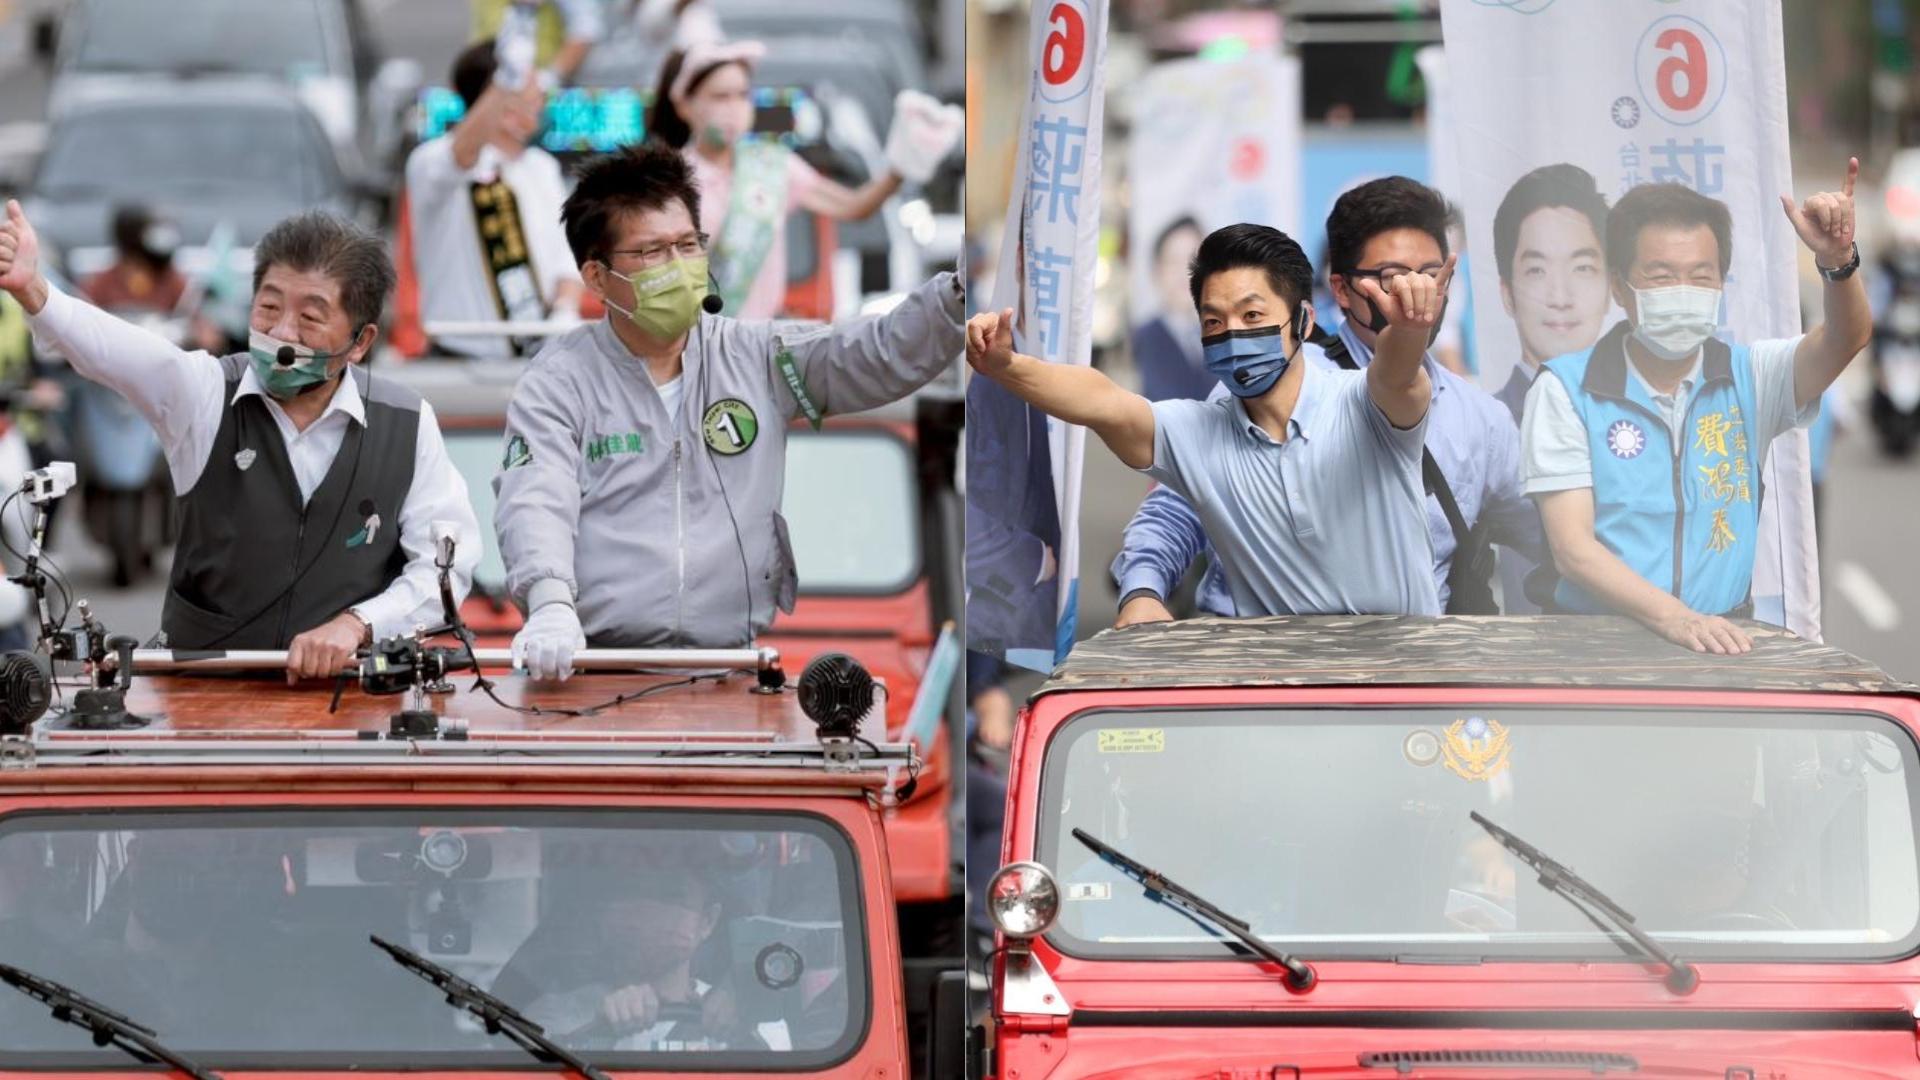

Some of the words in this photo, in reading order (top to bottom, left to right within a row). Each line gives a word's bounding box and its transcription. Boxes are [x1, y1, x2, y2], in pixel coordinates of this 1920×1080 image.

[716, 412, 746, 447] 1
[1693, 411, 1737, 554] 費鴻泰
